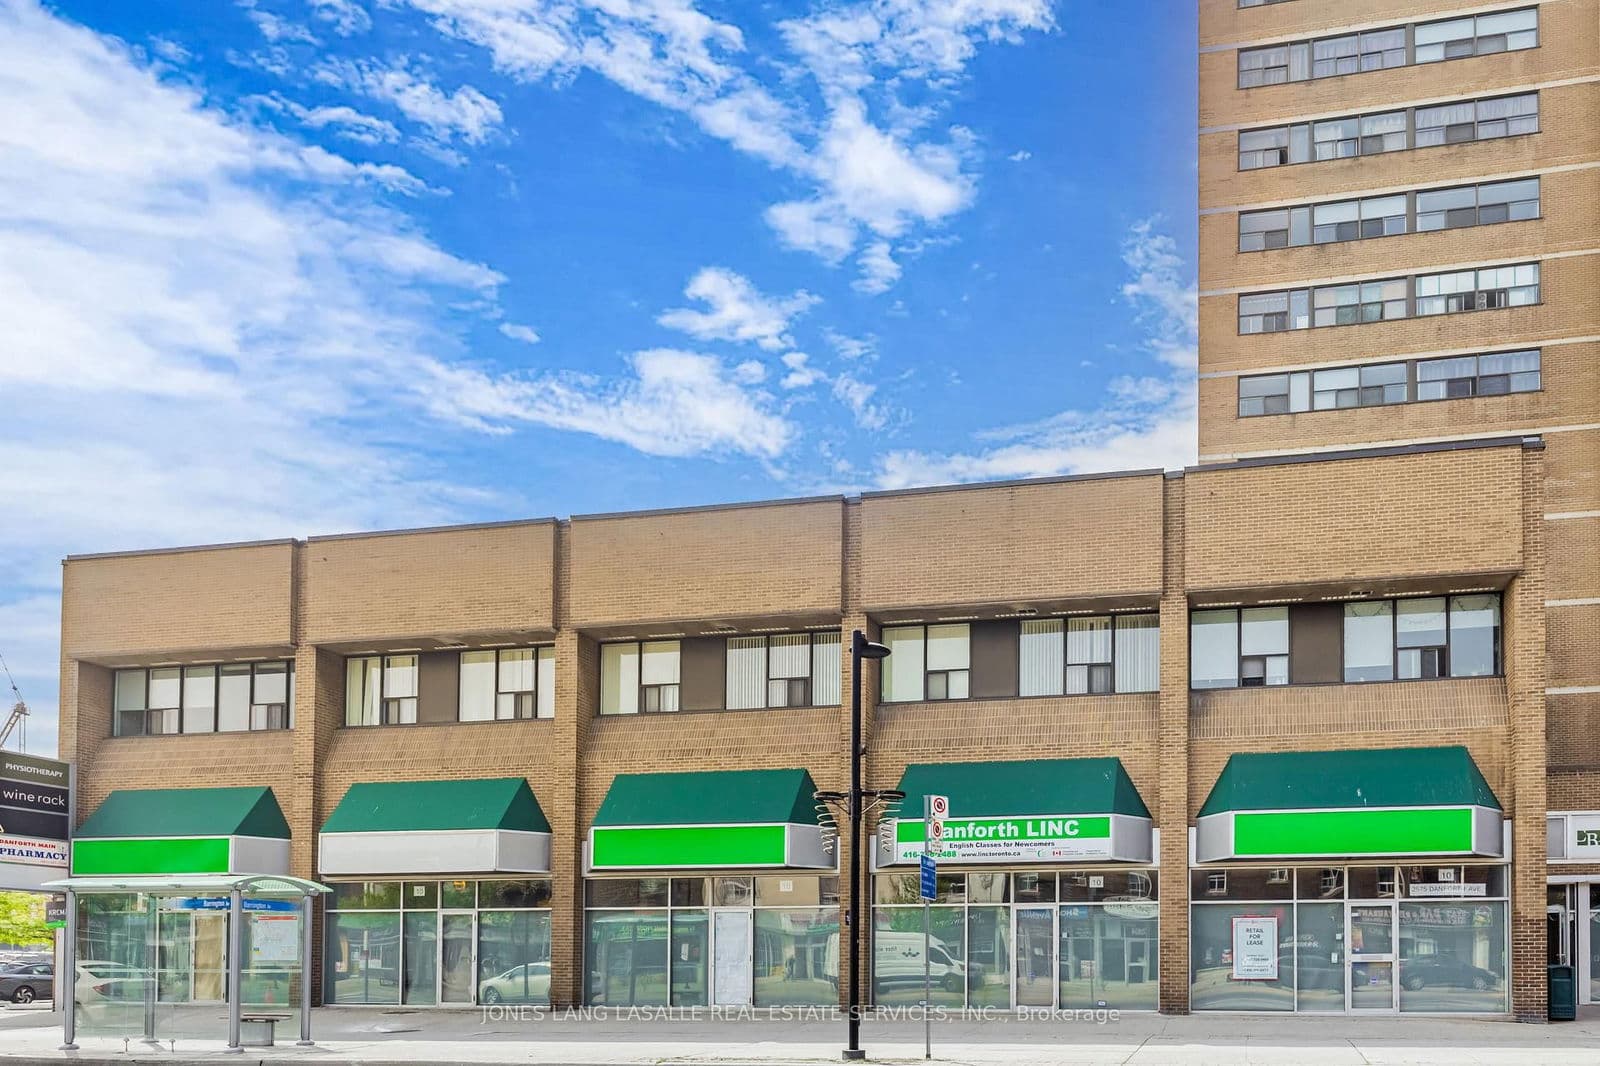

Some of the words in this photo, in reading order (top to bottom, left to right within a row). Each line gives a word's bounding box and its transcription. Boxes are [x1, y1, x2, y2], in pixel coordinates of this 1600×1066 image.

[5, 763, 63, 777] PHYSIOTHERAPY
[3, 789, 35, 802] wine
[38, 795, 65, 806] rack
[928, 822, 1019, 839] anforth
[1026, 820, 1080, 837] LINC
[949, 842, 974, 850] English
[1014, 840, 1055, 848] Newcomers
[0, 847, 67, 860] PHARMACY
[1442, 871, 1452, 879] 10
